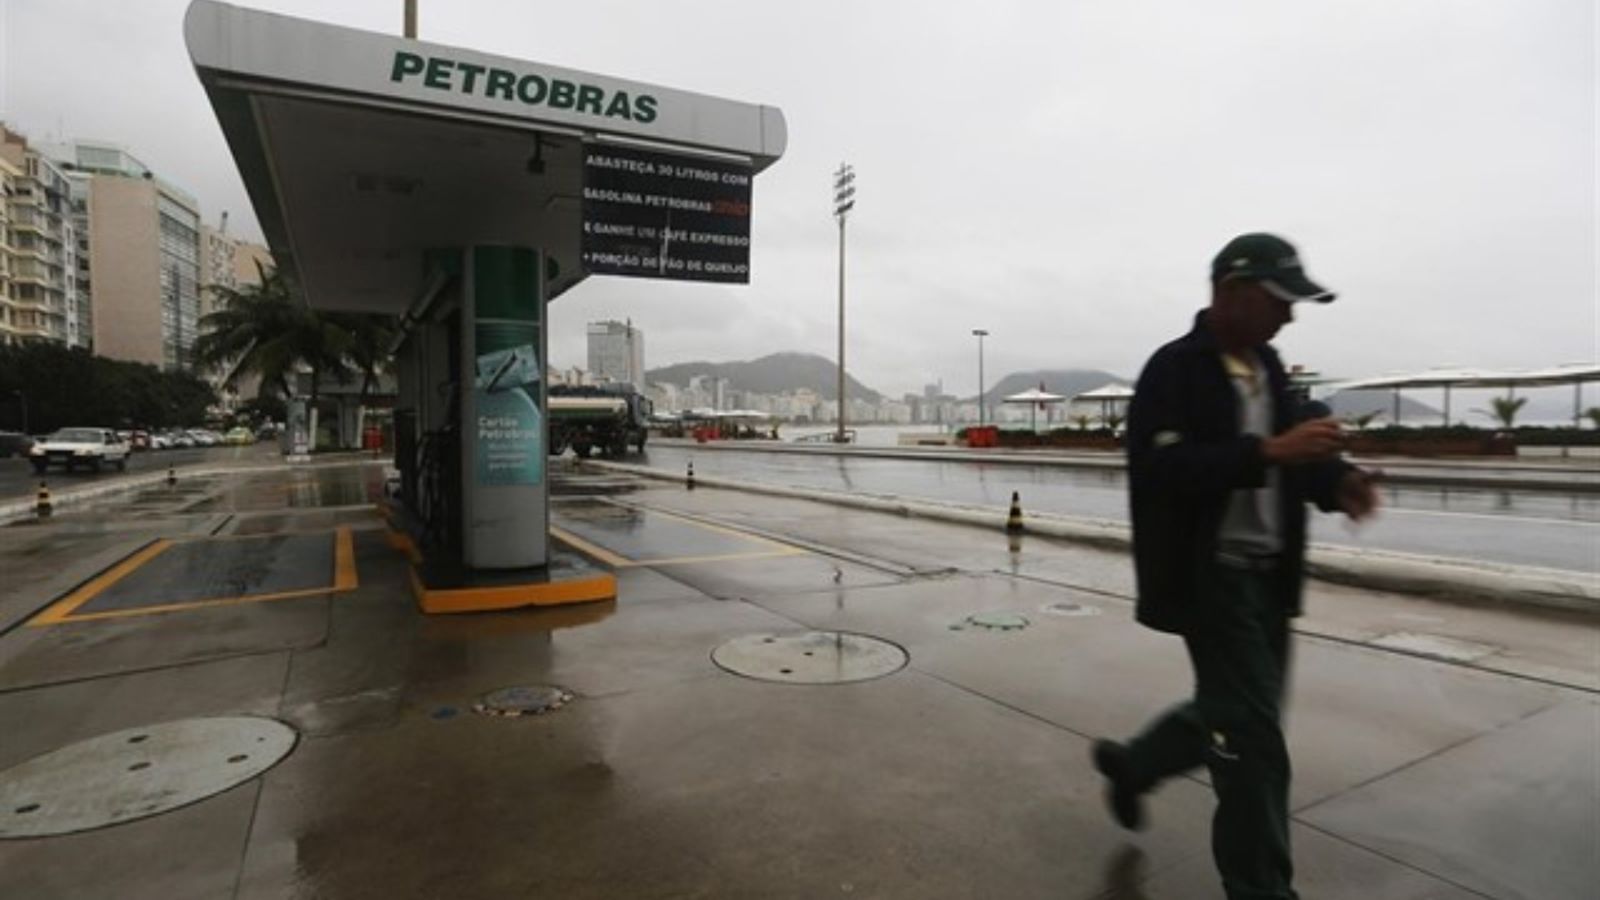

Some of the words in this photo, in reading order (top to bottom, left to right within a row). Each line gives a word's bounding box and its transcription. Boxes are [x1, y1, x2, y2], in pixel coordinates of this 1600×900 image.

[391, 52, 658, 124] PETROBRAS
[586, 154, 655, 174] ABASTEÇA
[658, 164, 673, 176] 30
[676, 167, 718, 182] LITROS
[722, 172, 748, 186] COM
[645, 195, 712, 212] PETROBRAS
[594, 222, 635, 236] GANHE
[690, 233, 749, 247] EXPRESSO
[592, 252, 639, 267] PORÇÃO
[642, 256, 657, 267] DE
[687, 260, 701, 271] DE
[704, 261, 747, 274] QUEIJO
